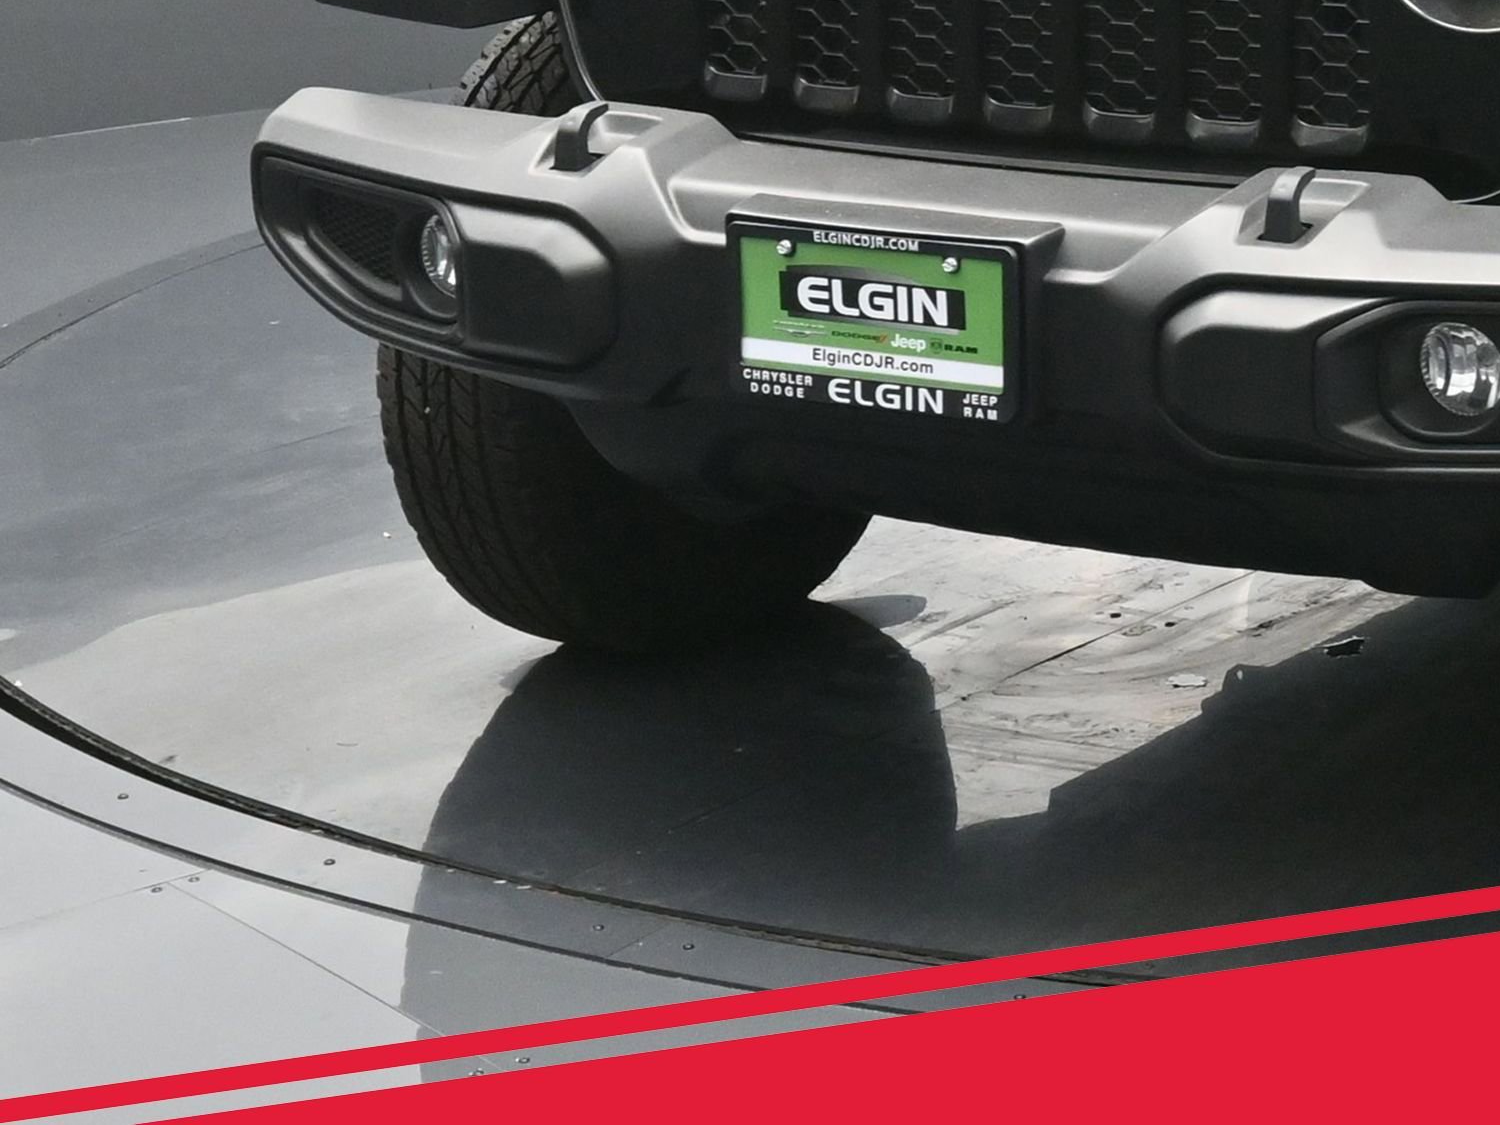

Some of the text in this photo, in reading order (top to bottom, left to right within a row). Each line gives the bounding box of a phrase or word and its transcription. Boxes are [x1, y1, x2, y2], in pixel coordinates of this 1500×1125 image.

[813, 231, 919, 252] ELGINCDJR.COM
[797, 276, 949, 326] ELGIN
[890, 333, 927, 352] Jeep
[943, 343, 979, 354] RAM
[811, 348, 934, 375] ElginCDJR.com
[743, 368, 813, 387] CHRYSLER
[750, 382, 806, 399] DODGE
[827, 378, 944, 414] ELGIN
[963, 392, 999, 407] JEEP
[963, 405, 999, 421] RAM
